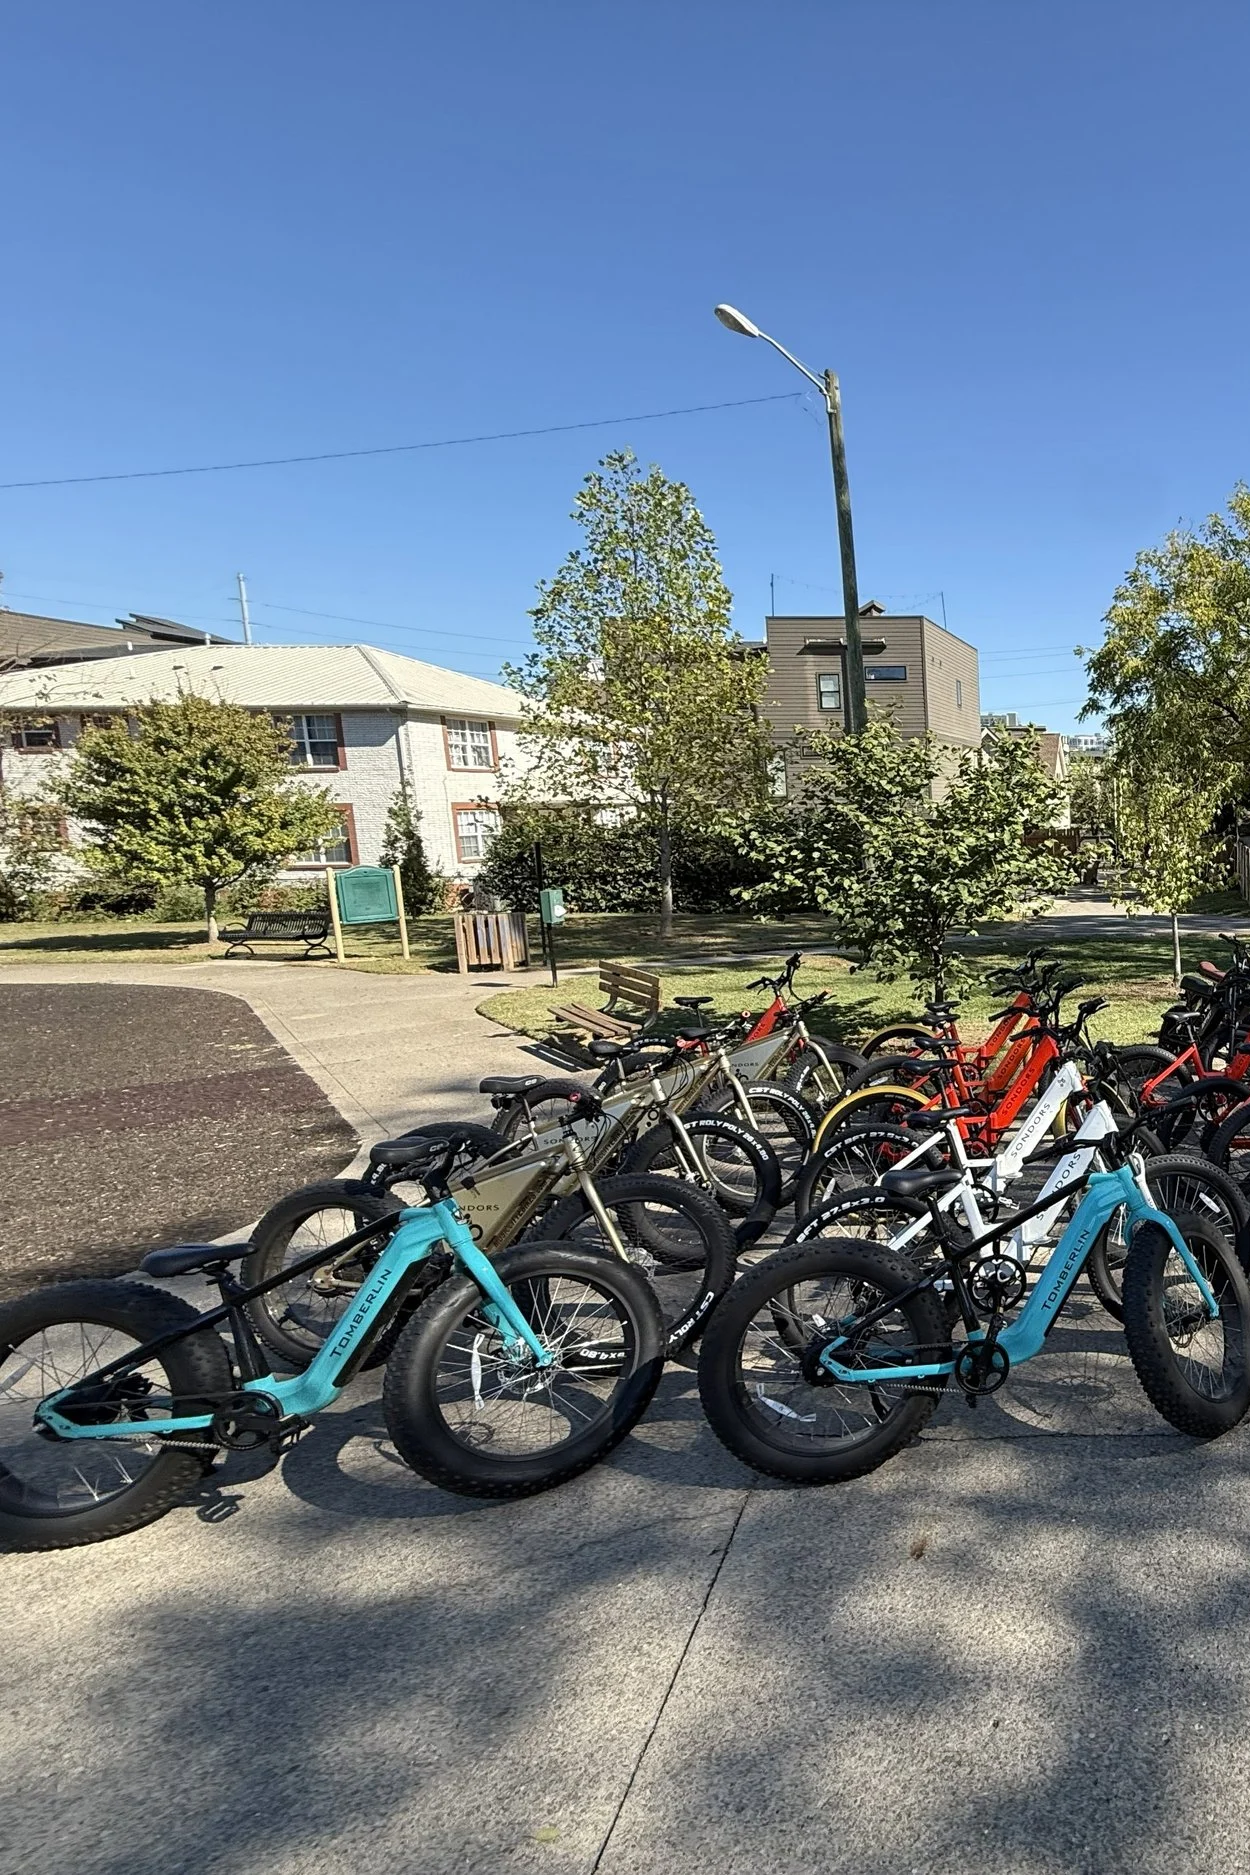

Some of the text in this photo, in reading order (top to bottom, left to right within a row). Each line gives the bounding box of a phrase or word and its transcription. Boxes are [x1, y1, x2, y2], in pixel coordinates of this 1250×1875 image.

[748, 1086, 771, 1095] CST
[769, 1087, 790, 1100] ROLY
[787, 1095, 806, 1112] POLY
[1002, 1067, 1035, 1116] SONDORS
[683, 1119, 770, 1161] ST ROLY POLY 26x4.80
[824, 1141, 843, 1159] CST
[869, 1131, 920, 1148] 27.5x3.0
[1010, 1102, 1051, 1159] SONDORS
[1036, 1153, 1081, 1221] SDORS
[458, 1203, 500, 1212] NDORS
[821, 1196, 885, 1221] 27.5x3.0
[1041, 1229, 1090, 1311] TOMBERLIN
[329, 1268, 392, 1357] TOMBERLIN
[694, 1290, 714, 1321] CST
[667, 1317, 697, 1344] ROLY
